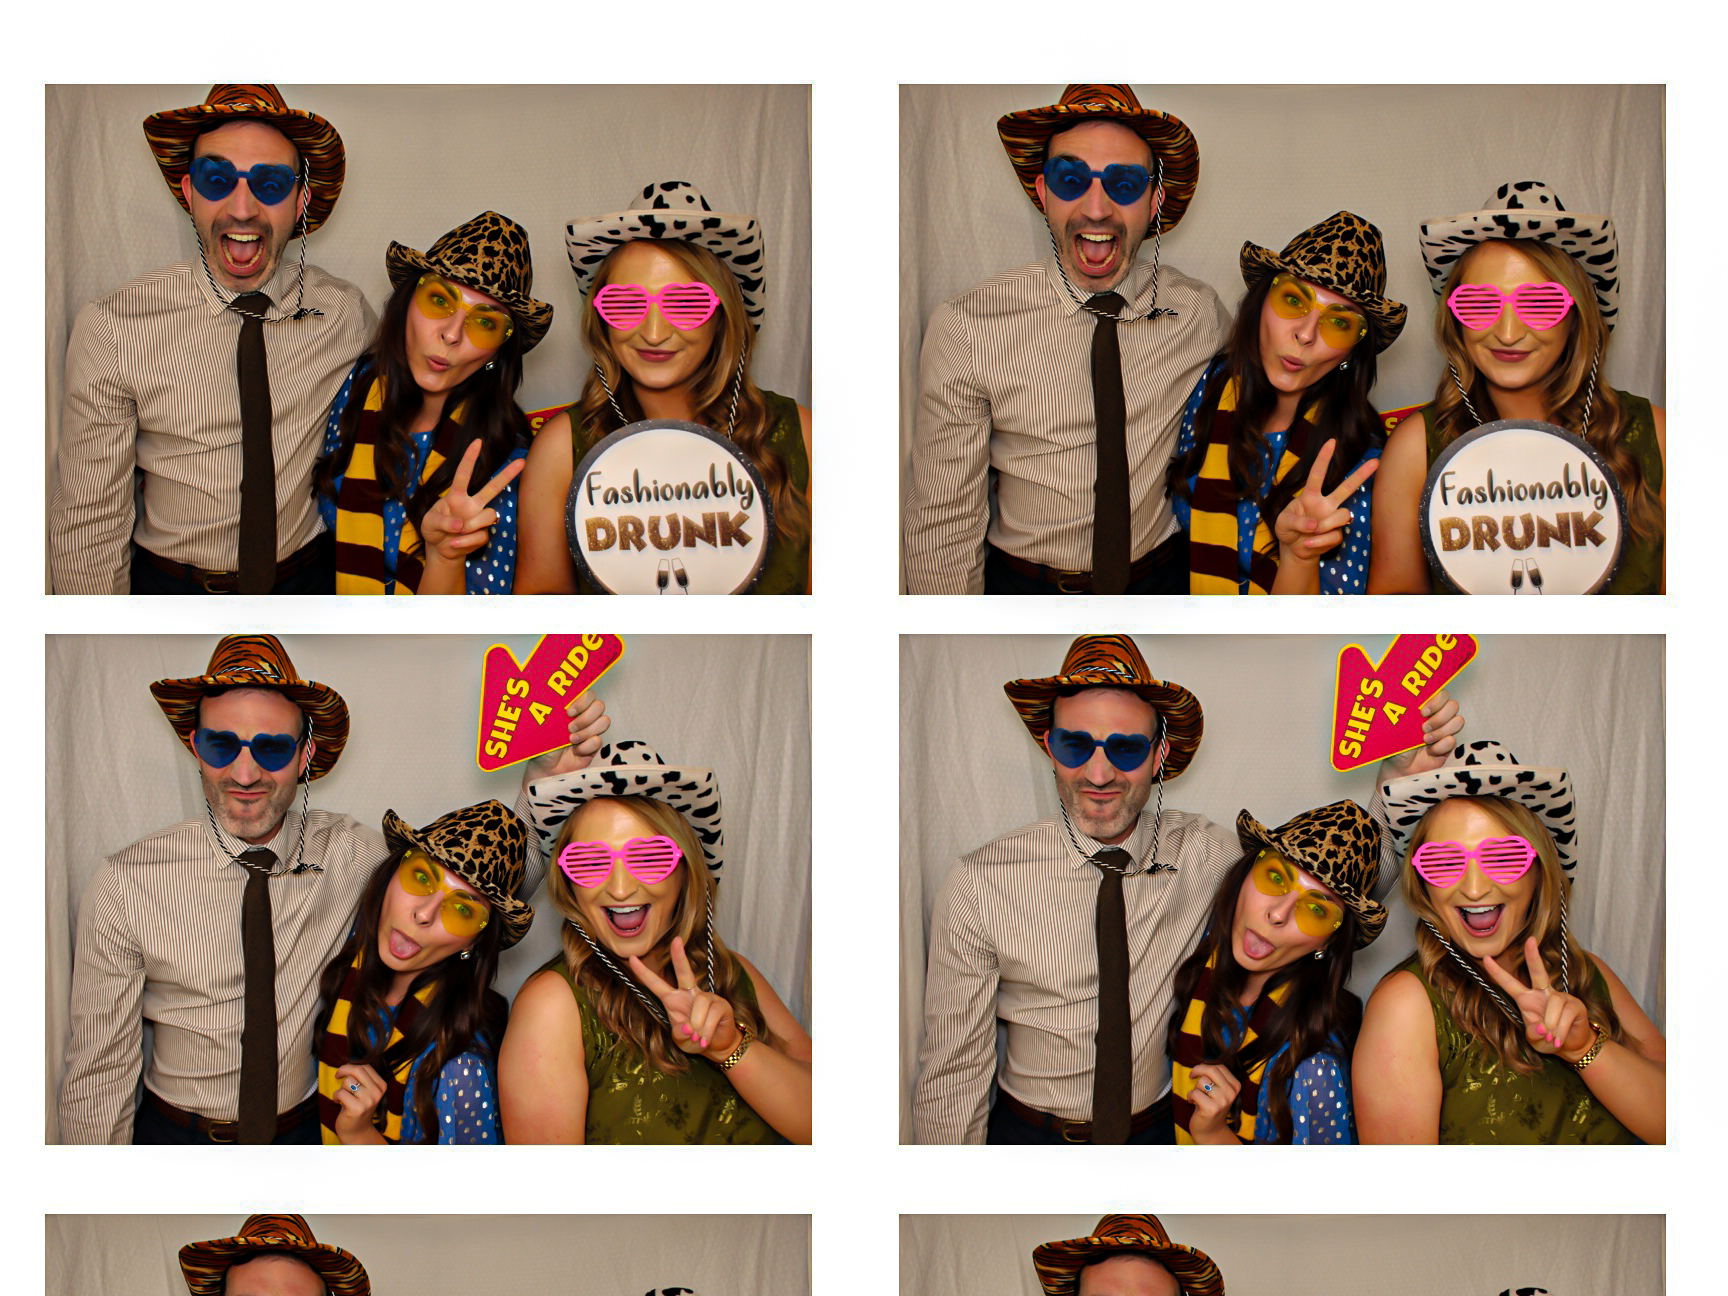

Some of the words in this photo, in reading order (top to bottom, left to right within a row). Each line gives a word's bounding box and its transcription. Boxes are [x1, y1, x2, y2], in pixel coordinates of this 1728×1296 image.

[586, 462, 754, 510] Fashionably
[1440, 462, 1608, 510] Fashionably
[584, 510, 753, 552] DRUNK
[1438, 510, 1607, 552] DRUNK
[485, 677, 530, 759] SHE'S
[528, 701, 553, 726] A
[1339, 677, 1384, 759] SHE'S
[1382, 701, 1407, 726] A
